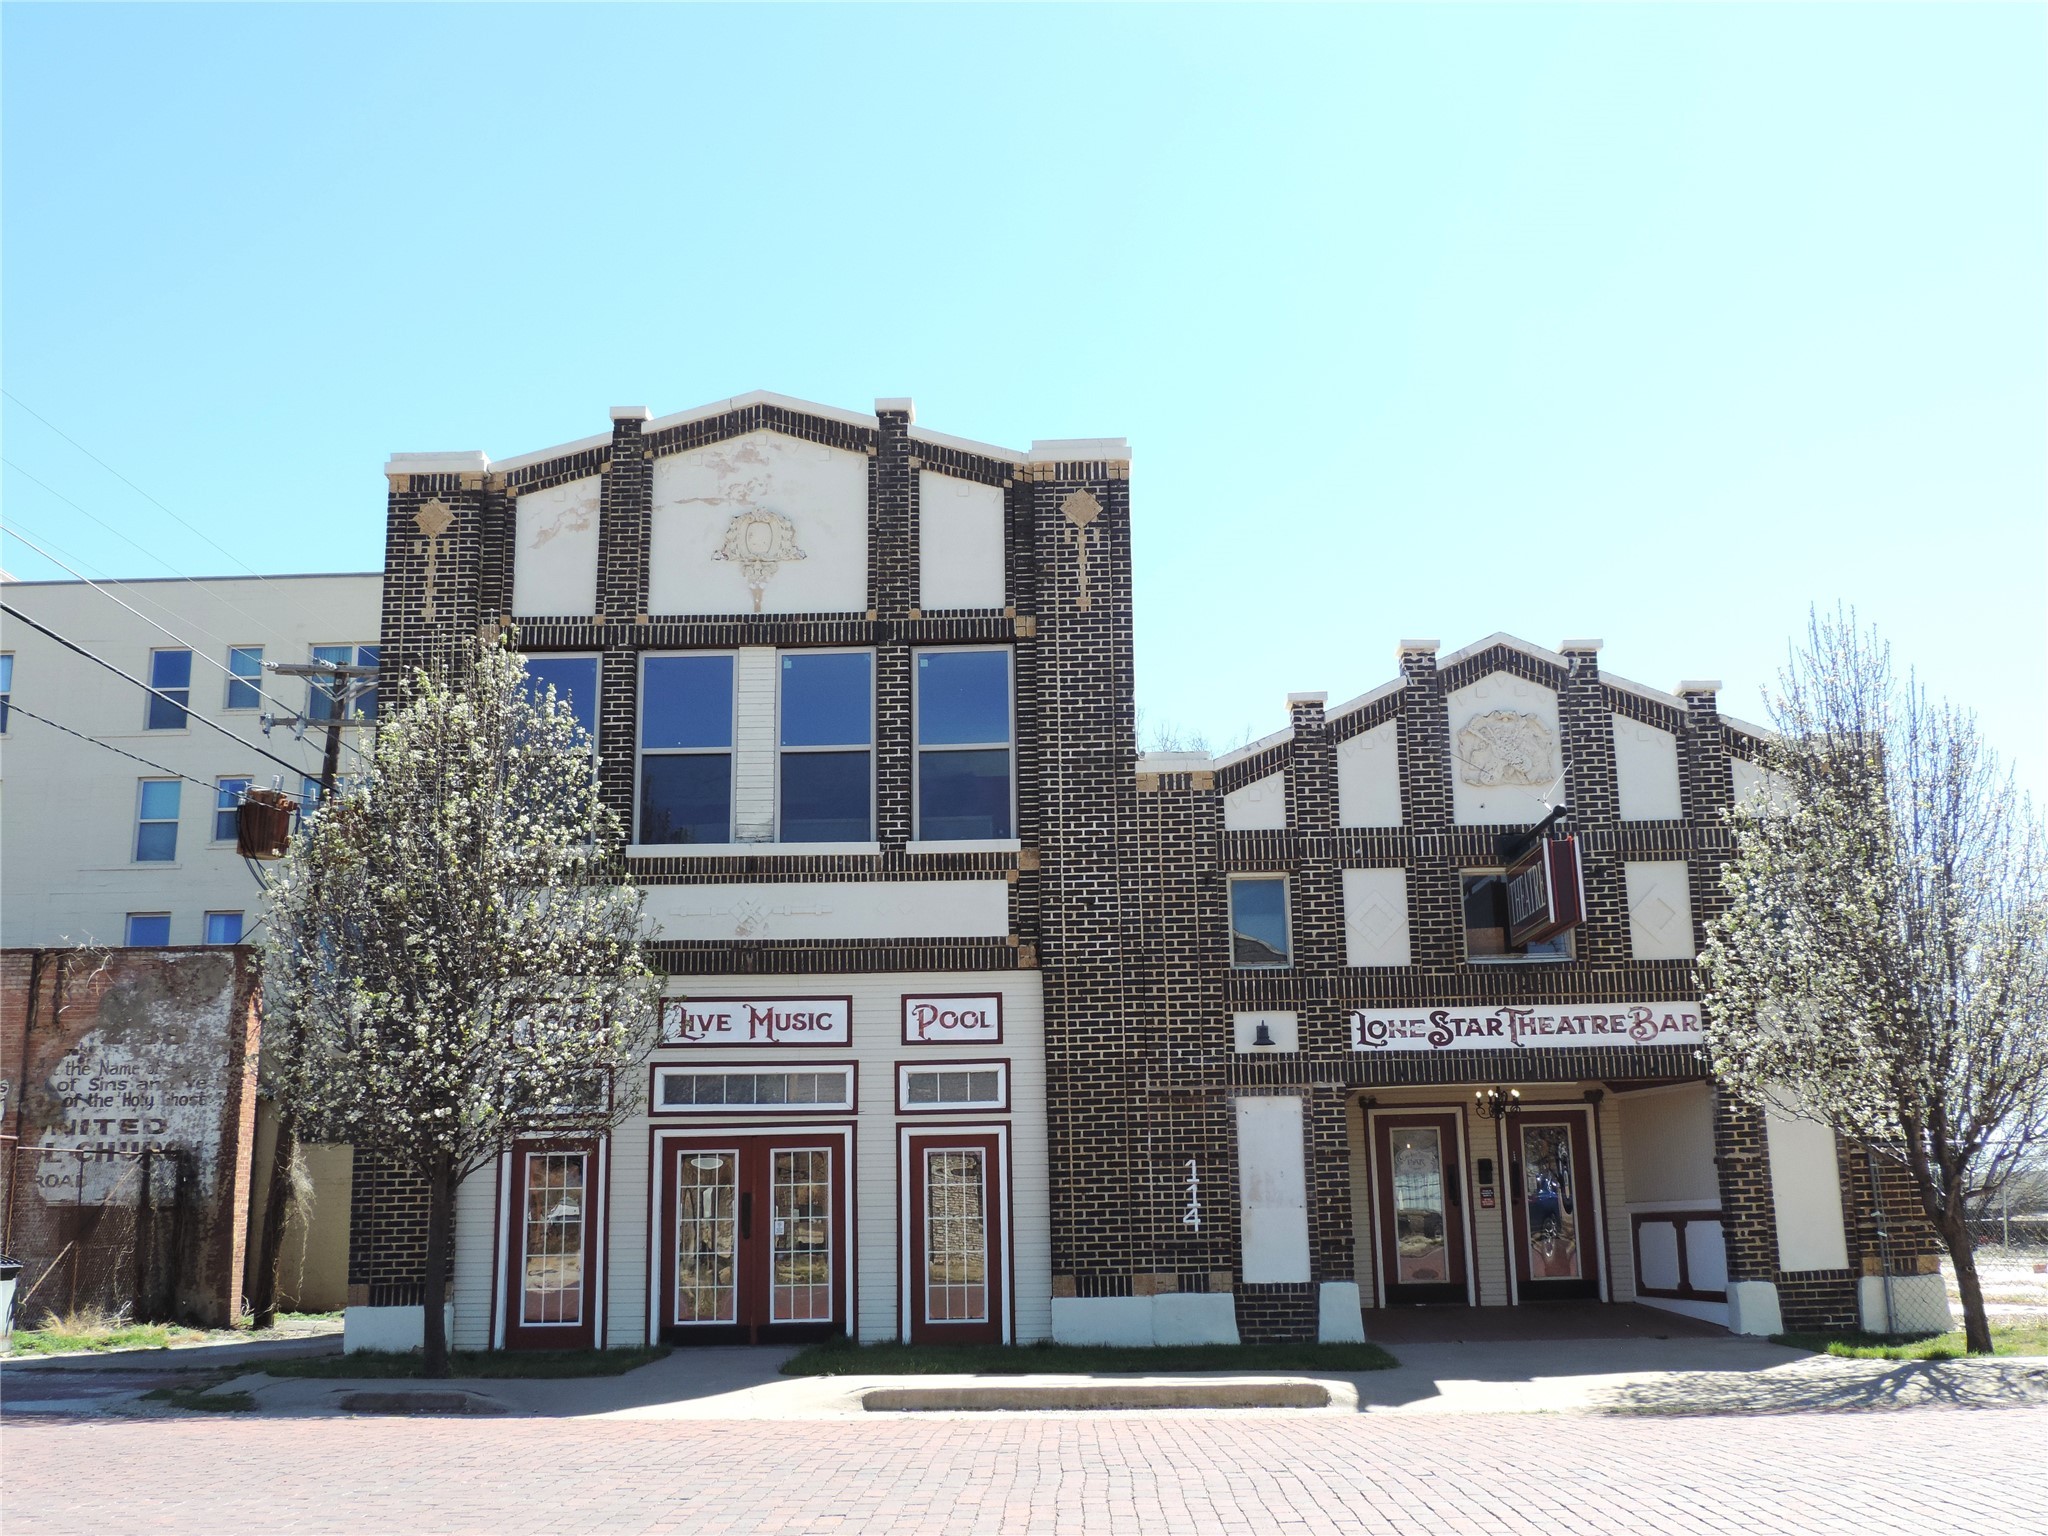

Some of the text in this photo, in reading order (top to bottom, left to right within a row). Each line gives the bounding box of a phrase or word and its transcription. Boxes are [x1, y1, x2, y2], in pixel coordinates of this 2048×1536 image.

[1509, 861, 1546, 925] THEATRE
[673, 1003, 833, 1042] LIVE MUSIC
[911, 1003, 994, 1040] POOL
[1350, 1006, 1699, 1049] LONE STAR THEATRE BAR
[56, 1079, 79, 1092] of
[88, 1078, 128, 1091] Sins
[65, 1061, 91, 1076] the
[99, 1059, 140, 1076] Name
[88, 1092, 114, 1107] the
[1183, 1159, 1201, 1232] 114
